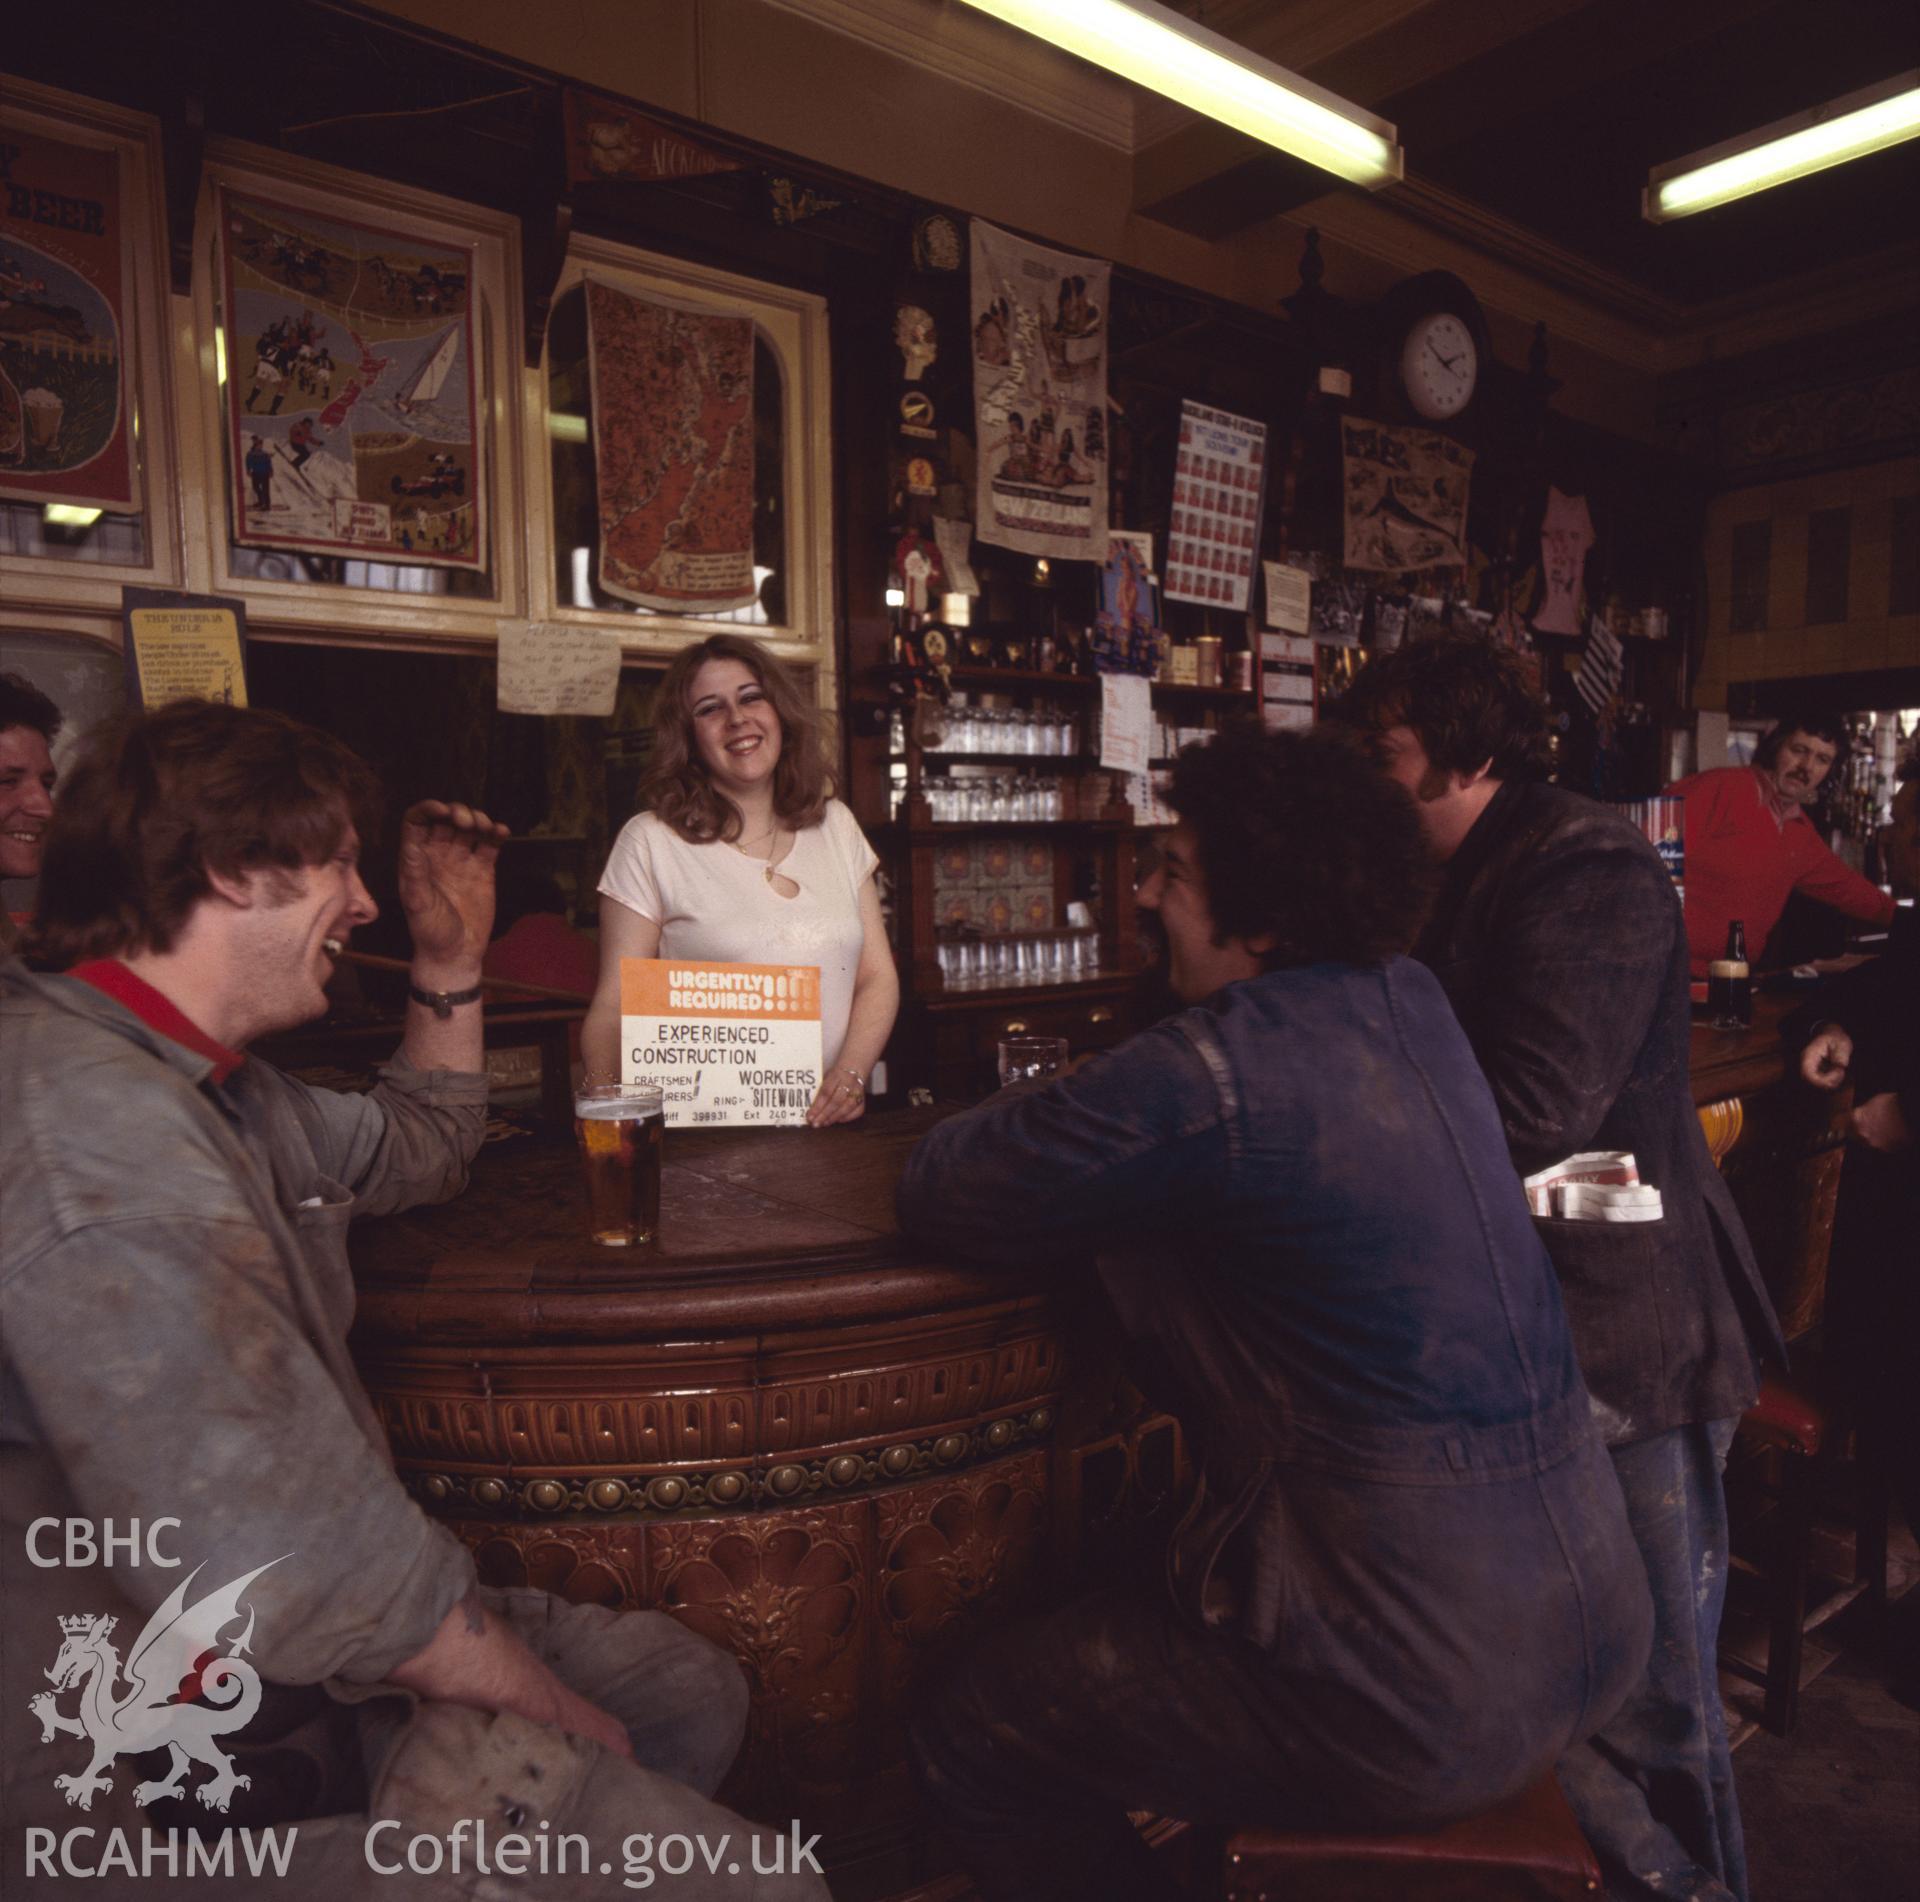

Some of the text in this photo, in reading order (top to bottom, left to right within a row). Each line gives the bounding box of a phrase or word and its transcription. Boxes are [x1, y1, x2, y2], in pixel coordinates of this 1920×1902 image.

[5, 181, 104, 236] BEER
[668, 970, 764, 992] URGENTLY
[669, 990, 763, 1011] REQUIRED
[658, 1024, 769, 1043] EXPERIENCED
[632, 1047, 757, 1066] CONSTRUCTION
[634, 1075, 693, 1087] CRAFTSMEN
[739, 1069, 817, 1086] WORKERS
[744, 1110, 760, 1120] Ext
[769, 1109, 787, 1119] 240
